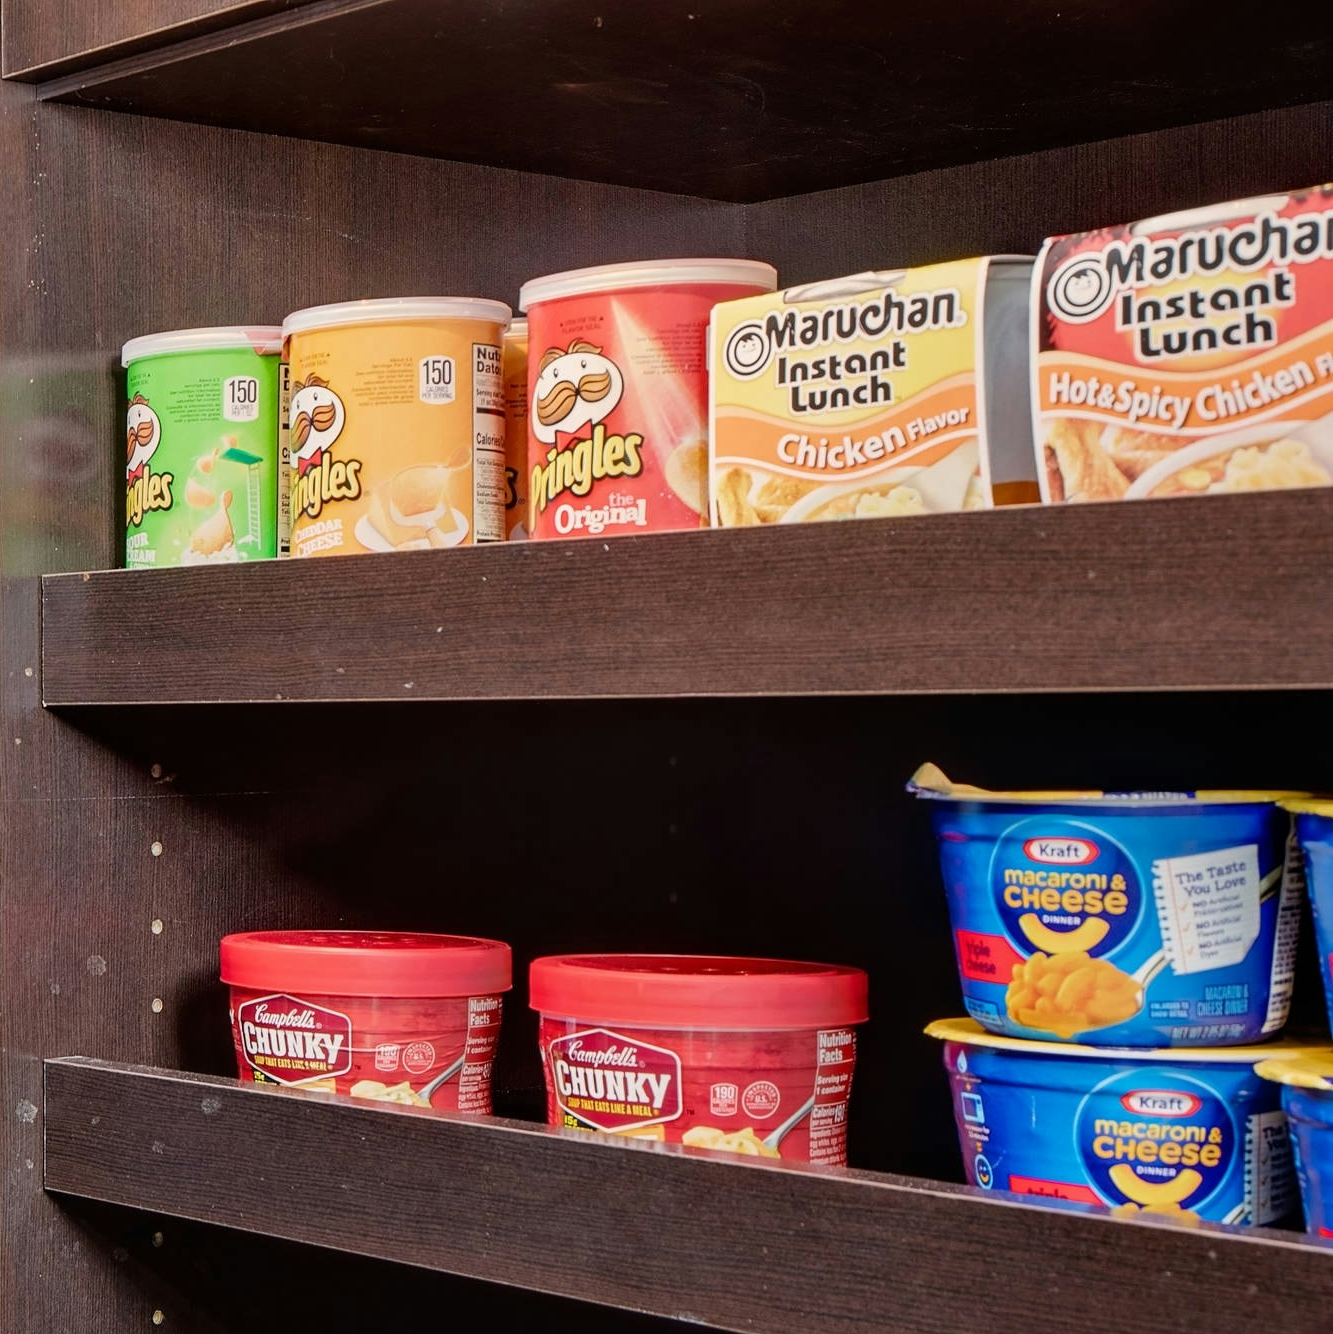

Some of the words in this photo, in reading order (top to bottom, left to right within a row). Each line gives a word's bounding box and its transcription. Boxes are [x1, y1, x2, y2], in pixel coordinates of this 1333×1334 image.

[1121, 271, 1293, 328] Instant
[765, 291, 958, 349] Maruchan
[1139, 313, 1275, 358] Lunch
[423, 360, 452, 385] 150
[777, 341, 907, 387] Instant
[228, 379, 257, 403] 150
[790, 374, 891, 414] Lunch
[1194, 354, 1315, 420] Chicken
[776, 424, 907, 469] Chicken
[908, 405, 971, 443] Flavor
[531, 423, 644, 534] Pringles
[609, 492, 633, 507] the
[554, 499, 647, 534] Original
[295, 519, 343, 543] CHEDDAR
[296, 532, 344, 558] CHEESE
[1038, 843, 1082, 858] Kraft
[1003, 868, 1108, 891] macaroni
[1111, 873, 1127, 891] &
[1174, 872, 1204, 886] The
[1206, 861, 1247, 880] Taste
[1182, 883, 1212, 898] You
[1214, 875, 1247, 891] Love
[1042, 914, 1081, 926] DINNER
[1196, 922, 1211, 931] NO
[1199, 941, 1213, 950] NO
[254, 1003, 315, 1030] Campbell's
[470, 999, 498, 1012] Nutrition
[470, 1012, 491, 1026] Facts
[242, 1021, 345, 1064] CHUNKY
[819, 1032, 852, 1048] Nutrition
[568, 1040, 637, 1068] Campbell's
[819, 1048, 844, 1063] Facts
[555, 1060, 672, 1109] CHUNKY
[714, 1086, 735, 1099] 190
[567, 1097, 582, 1109] SOUP
[582, 1099, 595, 1111] THAT
[595, 1101, 609, 1113] EATS
[610, 1103, 625, 1114] LIKE
[625, 1105, 632, 1115] A
[632, 1105, 652, 1117] MEAL
[1139, 1096, 1184, 1112] Kraft
[1094, 1118, 1206, 1142] macaroni
[1208, 1127, 1222, 1144] &
[1136, 1164, 1177, 1177] DINNER
